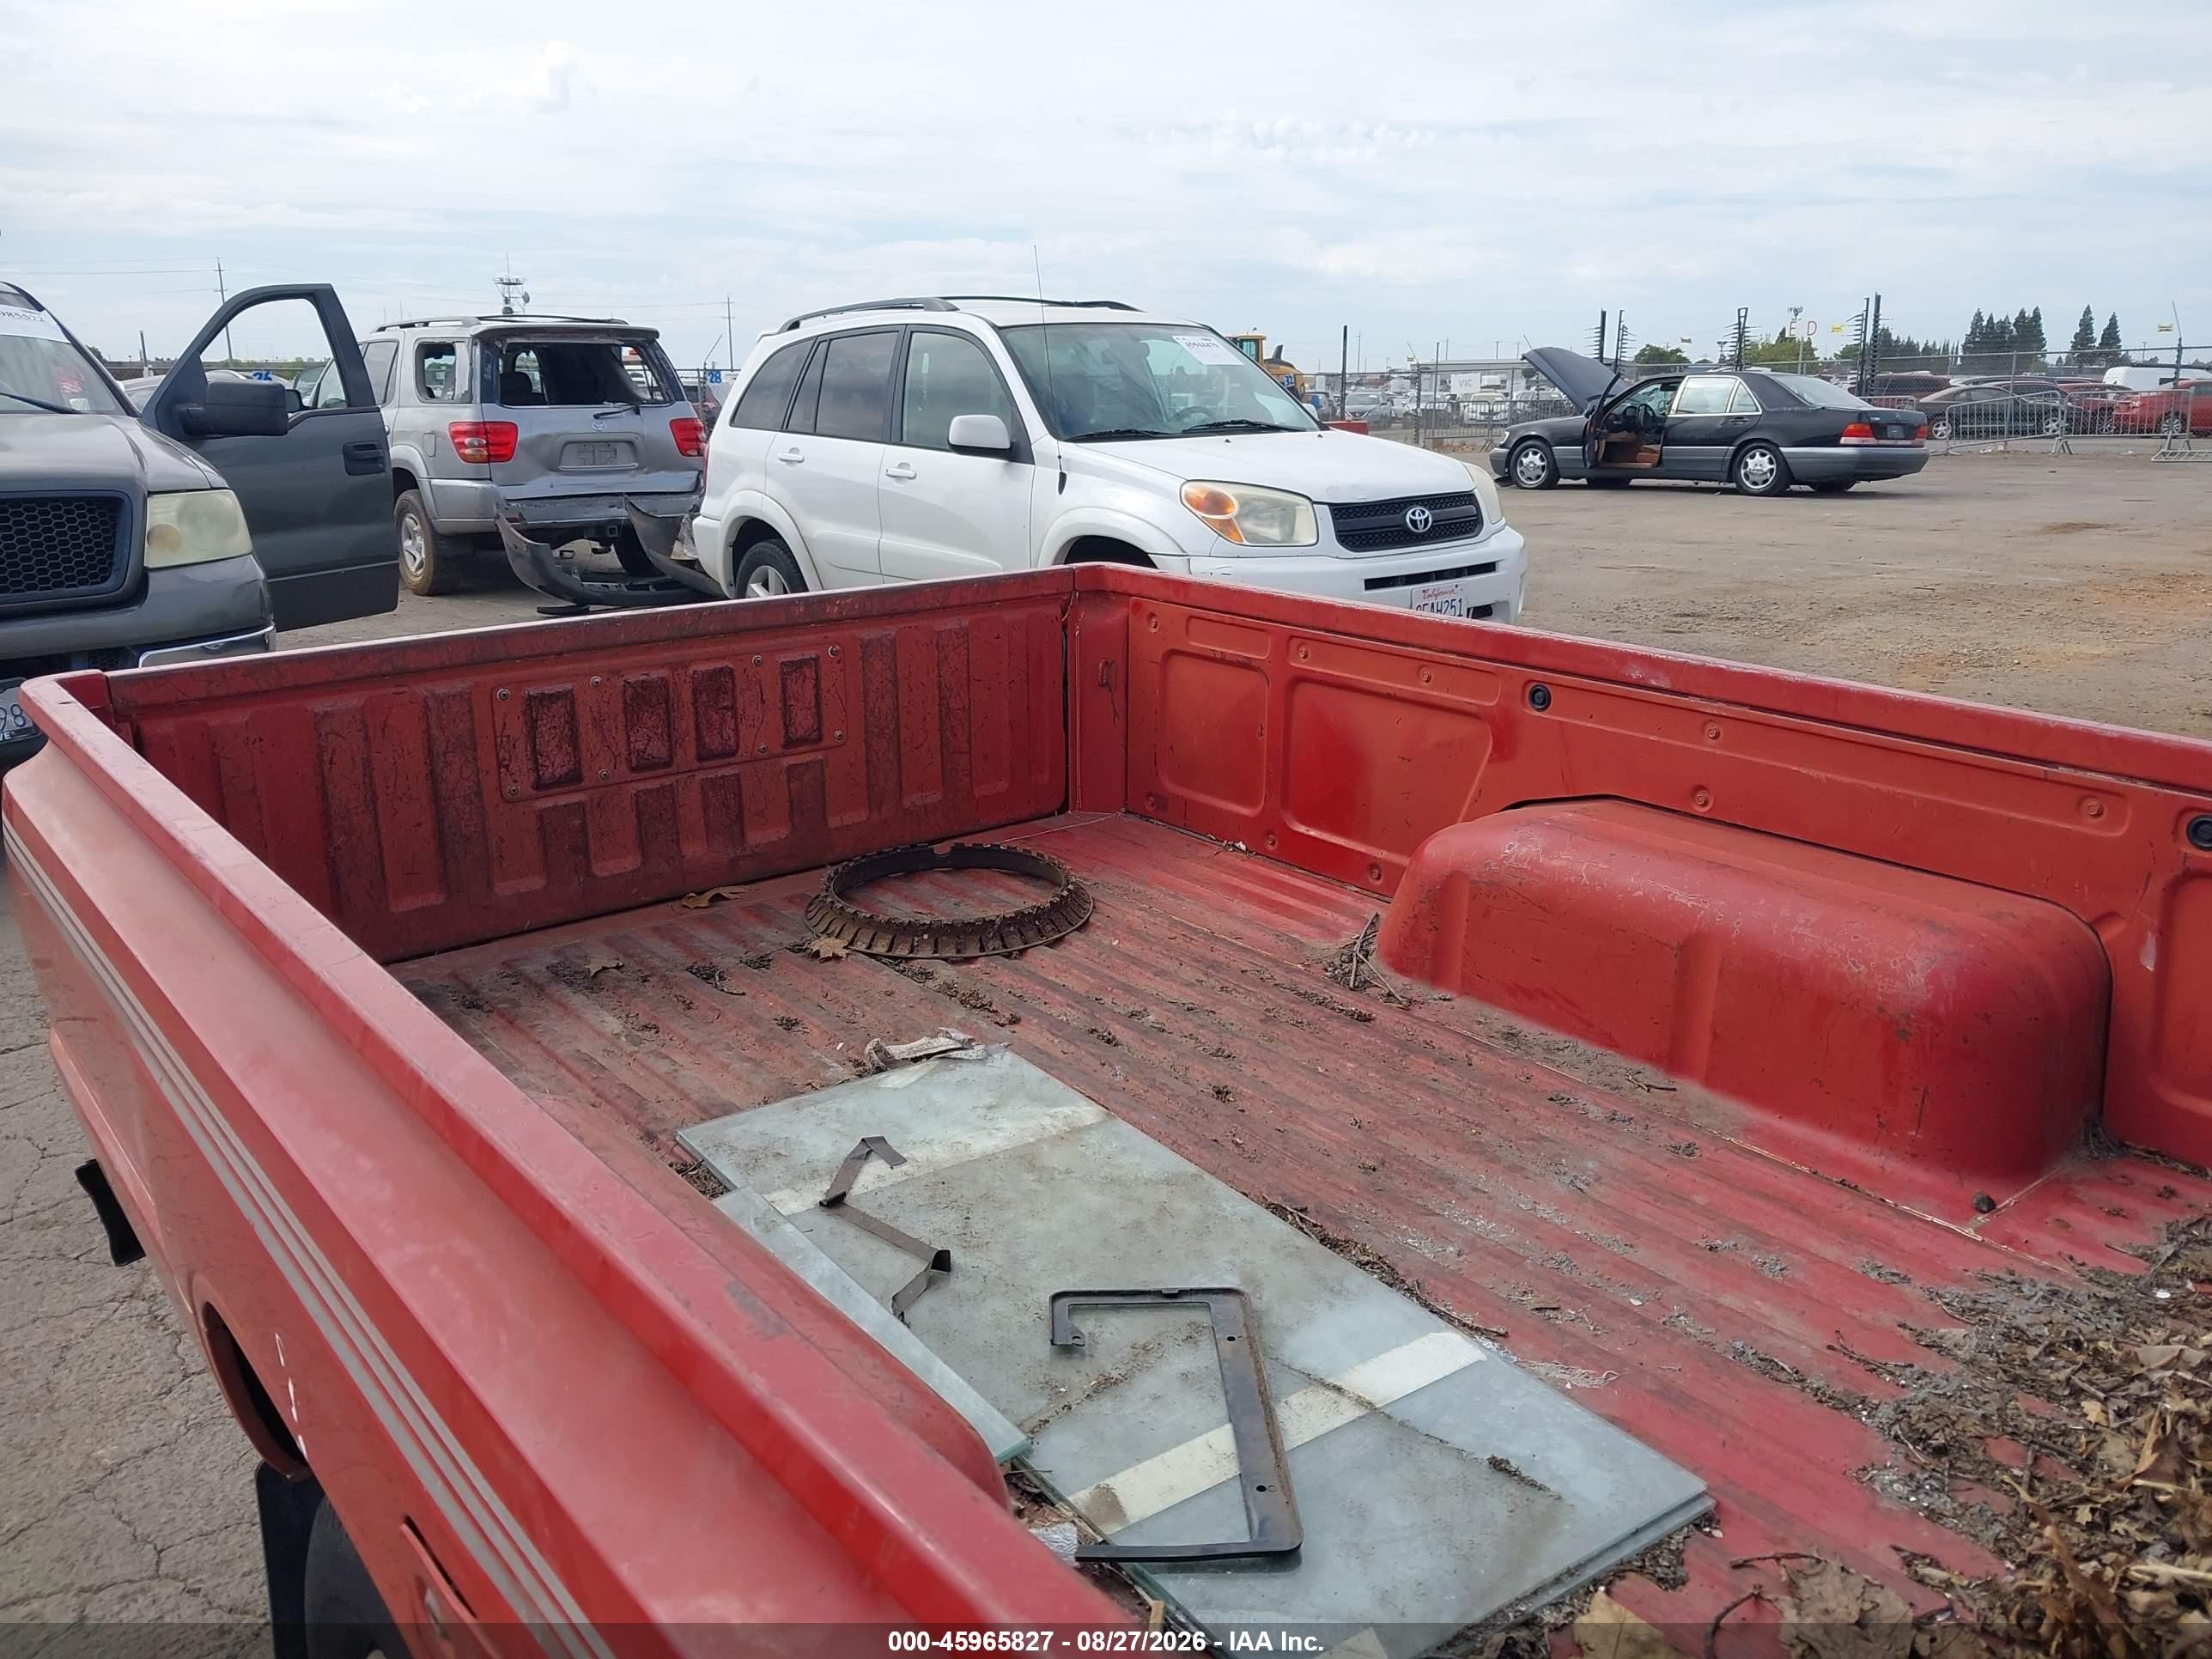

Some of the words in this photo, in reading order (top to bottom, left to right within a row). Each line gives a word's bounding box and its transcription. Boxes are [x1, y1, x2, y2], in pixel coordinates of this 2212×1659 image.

[1790, 321, 1797, 336] E
[1807, 320, 1818, 336] D
[708, 371, 722, 384] 28
